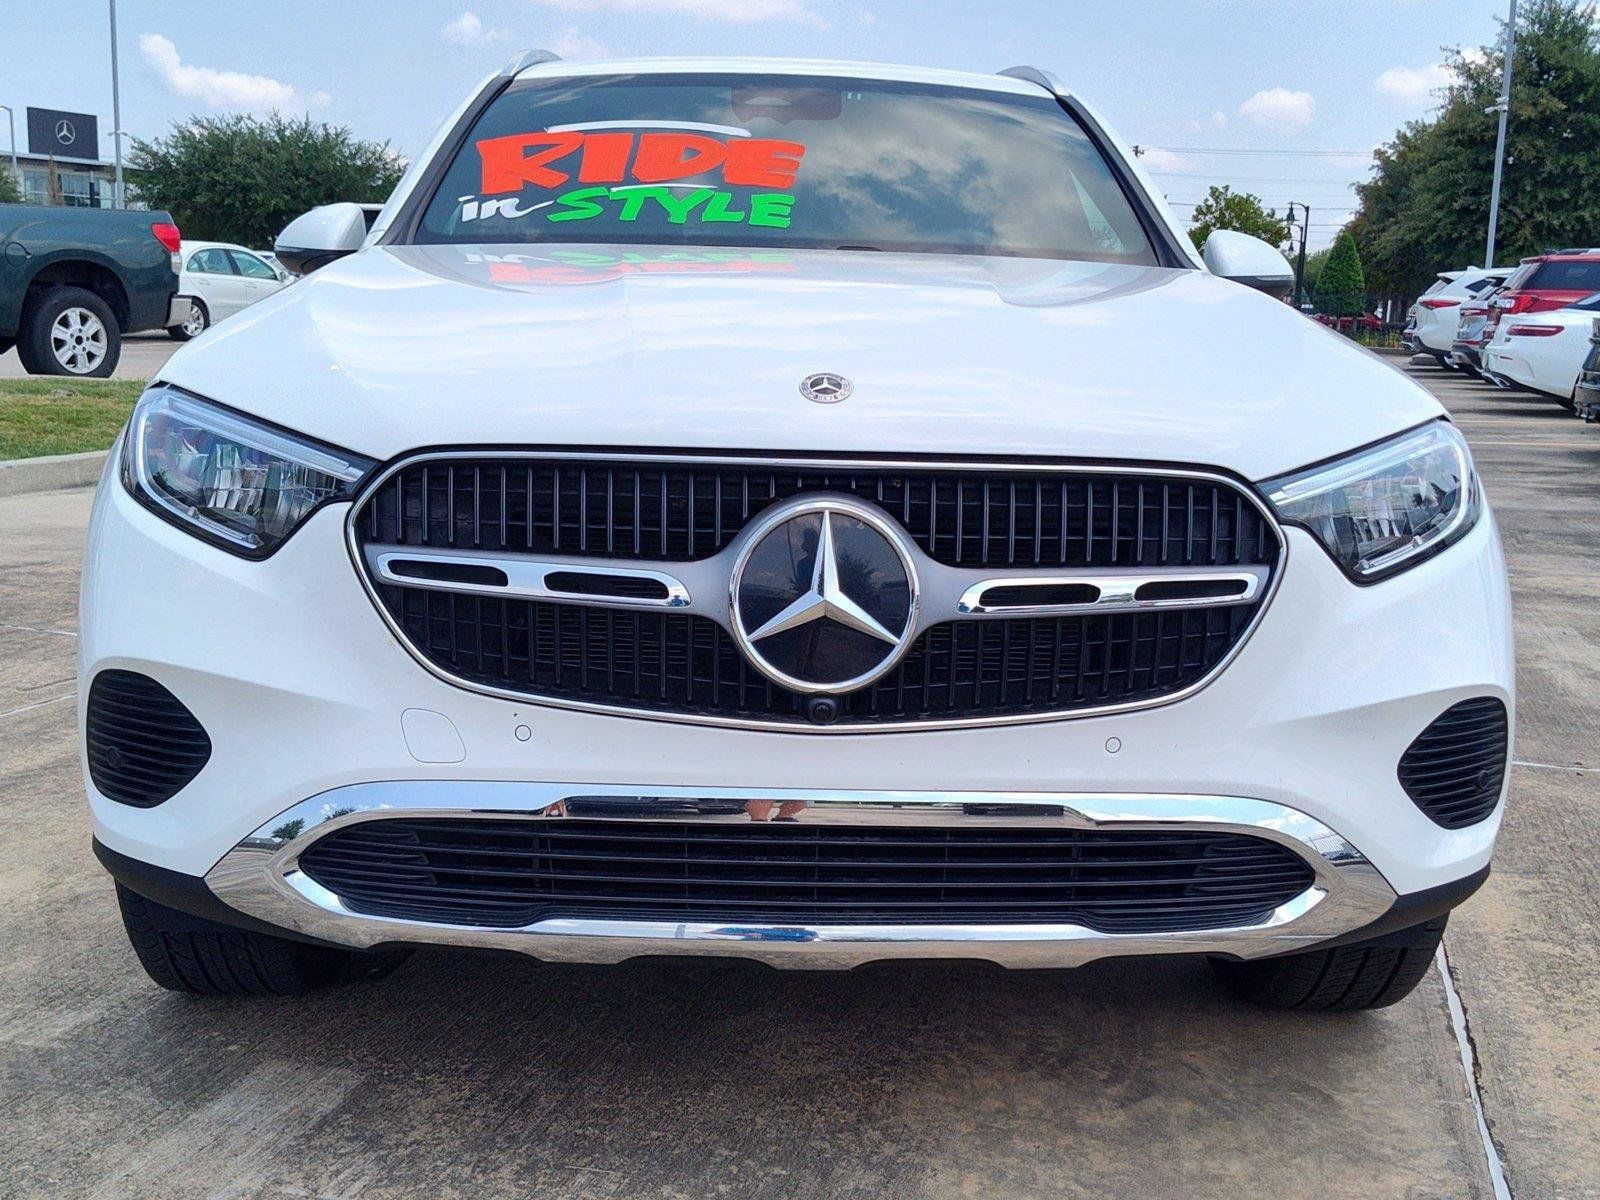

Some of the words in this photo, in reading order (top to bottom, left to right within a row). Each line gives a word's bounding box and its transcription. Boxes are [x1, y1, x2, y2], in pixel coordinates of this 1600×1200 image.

[476, 131, 806, 194] RIDE
[457, 195, 554, 222] in
[546, 186, 796, 228] STYLE
